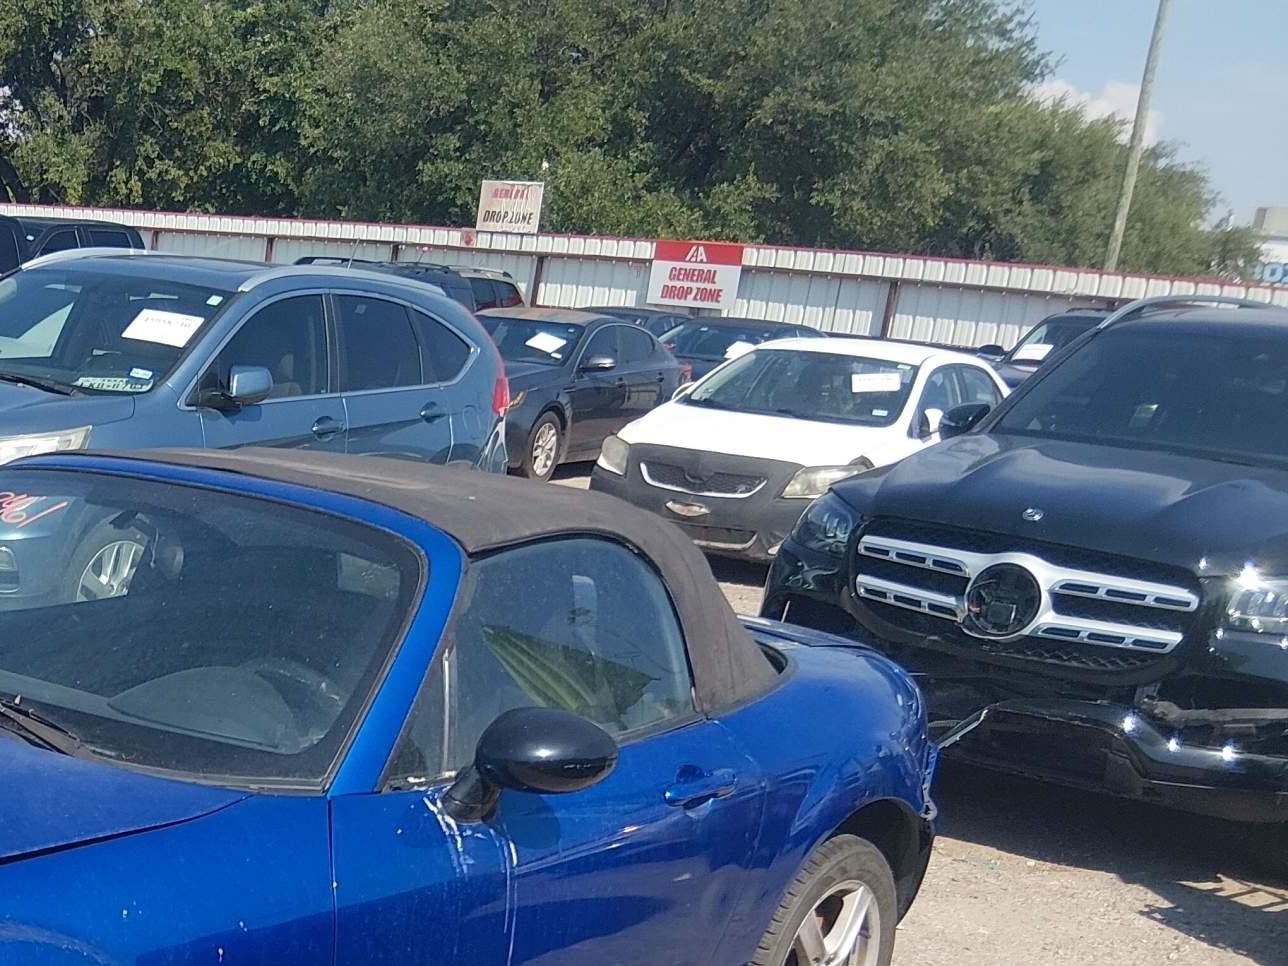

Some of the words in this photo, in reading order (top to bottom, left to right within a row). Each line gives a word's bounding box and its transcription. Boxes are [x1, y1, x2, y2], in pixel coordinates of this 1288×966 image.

[668, 266, 718, 284] GENERAL
[659, 284, 693, 301] DROP
[693, 287, 724, 303] ZONE
